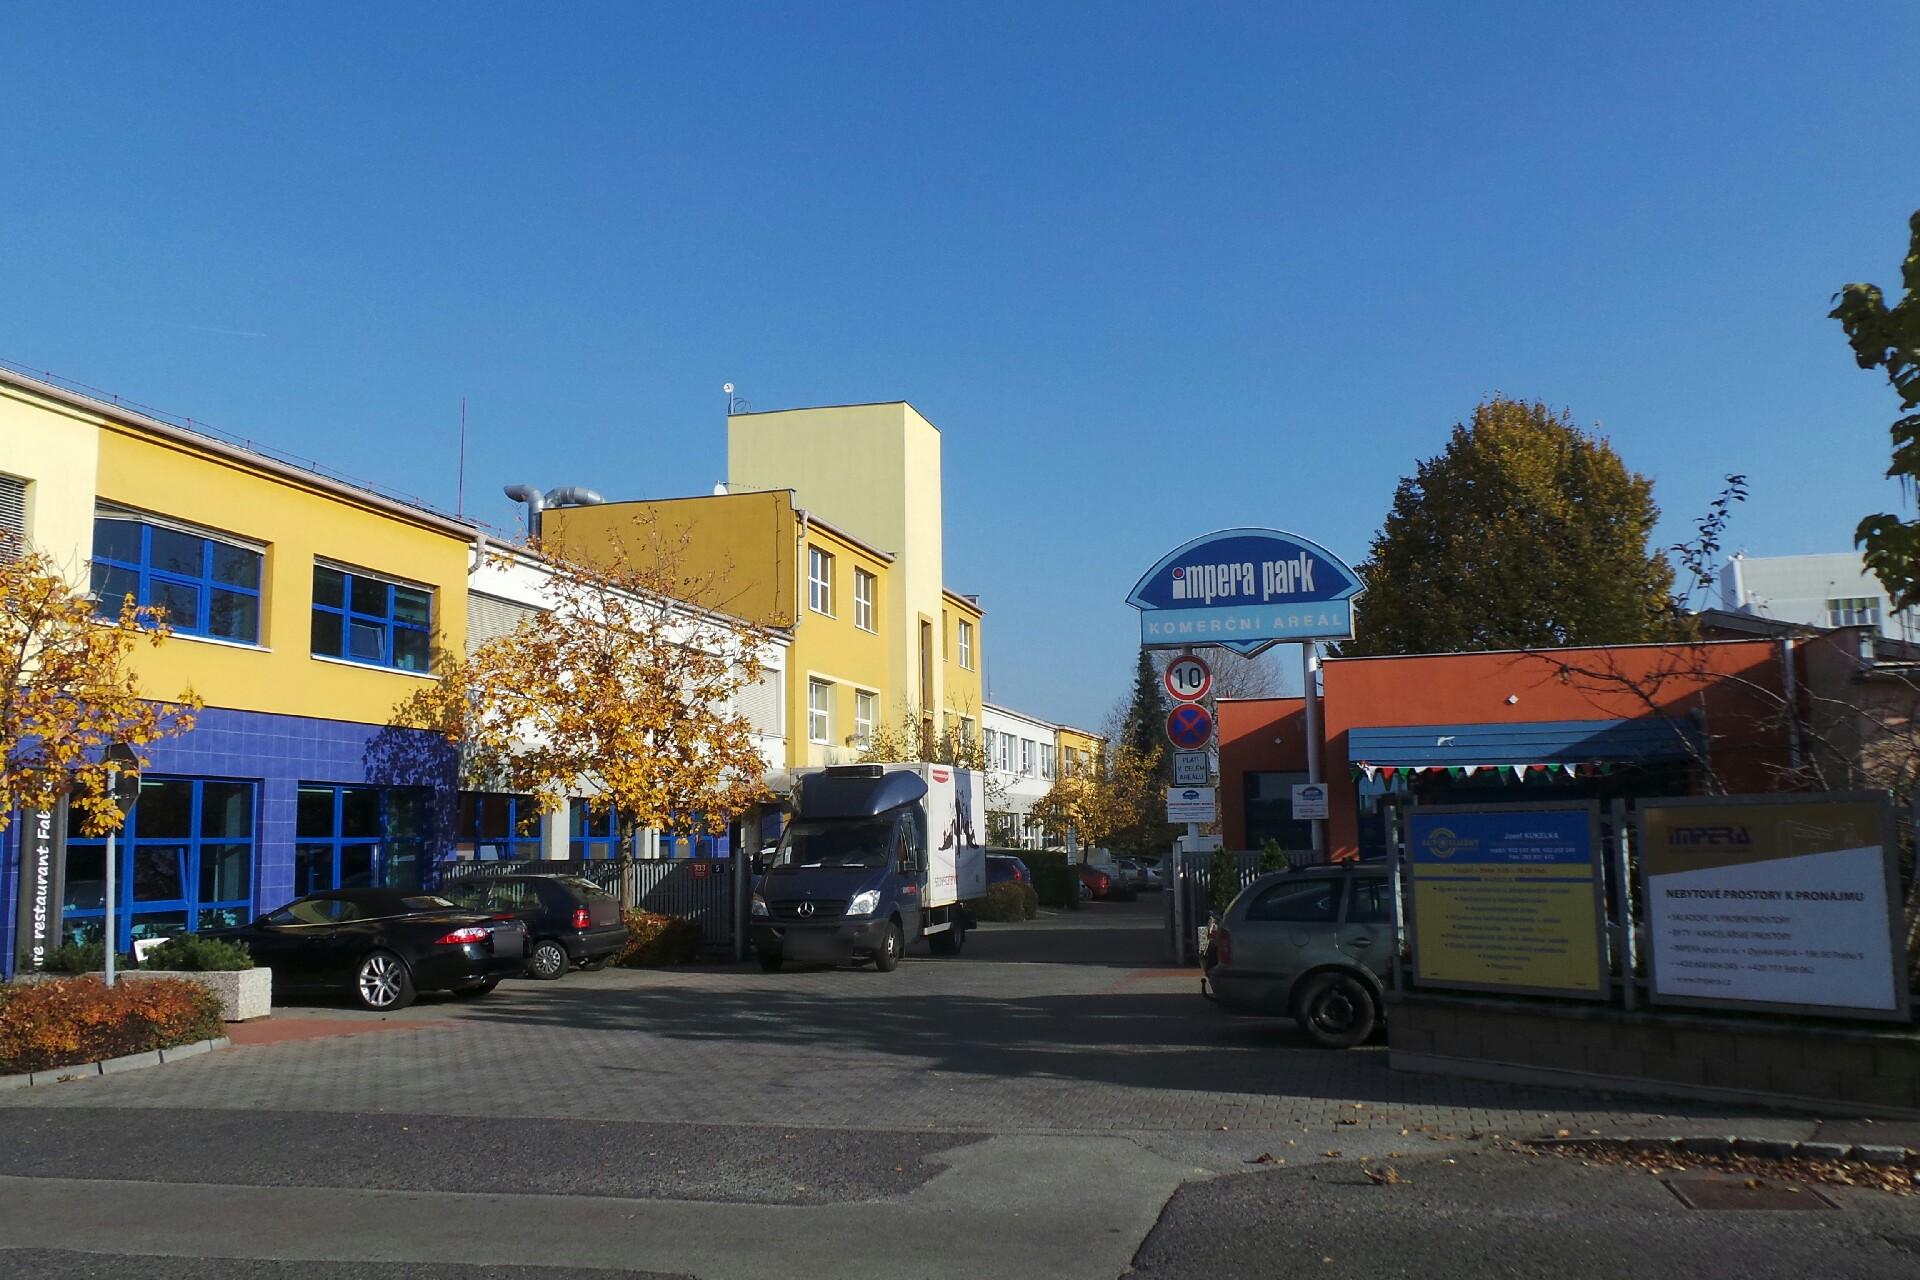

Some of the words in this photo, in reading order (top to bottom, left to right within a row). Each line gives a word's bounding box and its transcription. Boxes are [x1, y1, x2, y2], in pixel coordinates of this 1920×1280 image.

[1172, 559, 1256, 604] impera
[1262, 551, 1316, 601] park
[1149, 614, 1261, 635] KOMERČNÍ
[1273, 611, 1343, 629] AREÁL
[1174, 667, 1201, 690] 10
[32, 845, 51, 939] restaurant
[1723, 889, 1782, 901] PROSTORY
[1785, 891, 1794, 901] K
